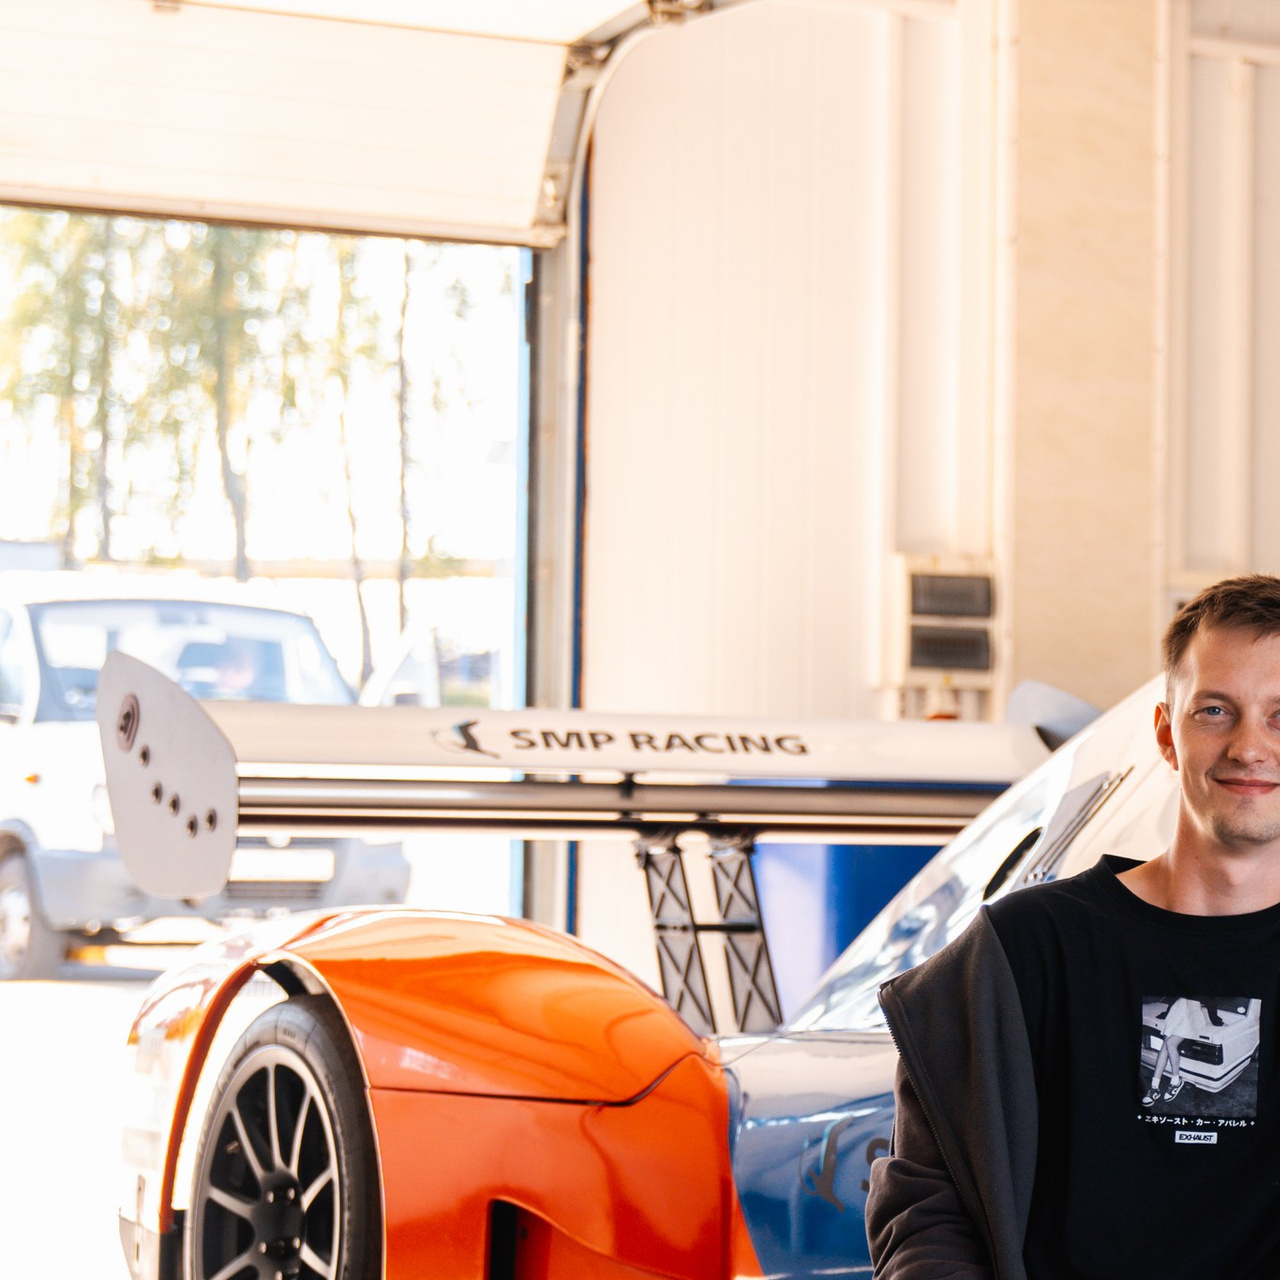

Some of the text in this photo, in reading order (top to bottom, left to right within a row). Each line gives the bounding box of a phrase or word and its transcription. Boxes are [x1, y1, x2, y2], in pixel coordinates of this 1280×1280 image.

[509, 729, 810, 756] SMP RACING
[1179, 1133, 1214, 1141] EXHAUST
